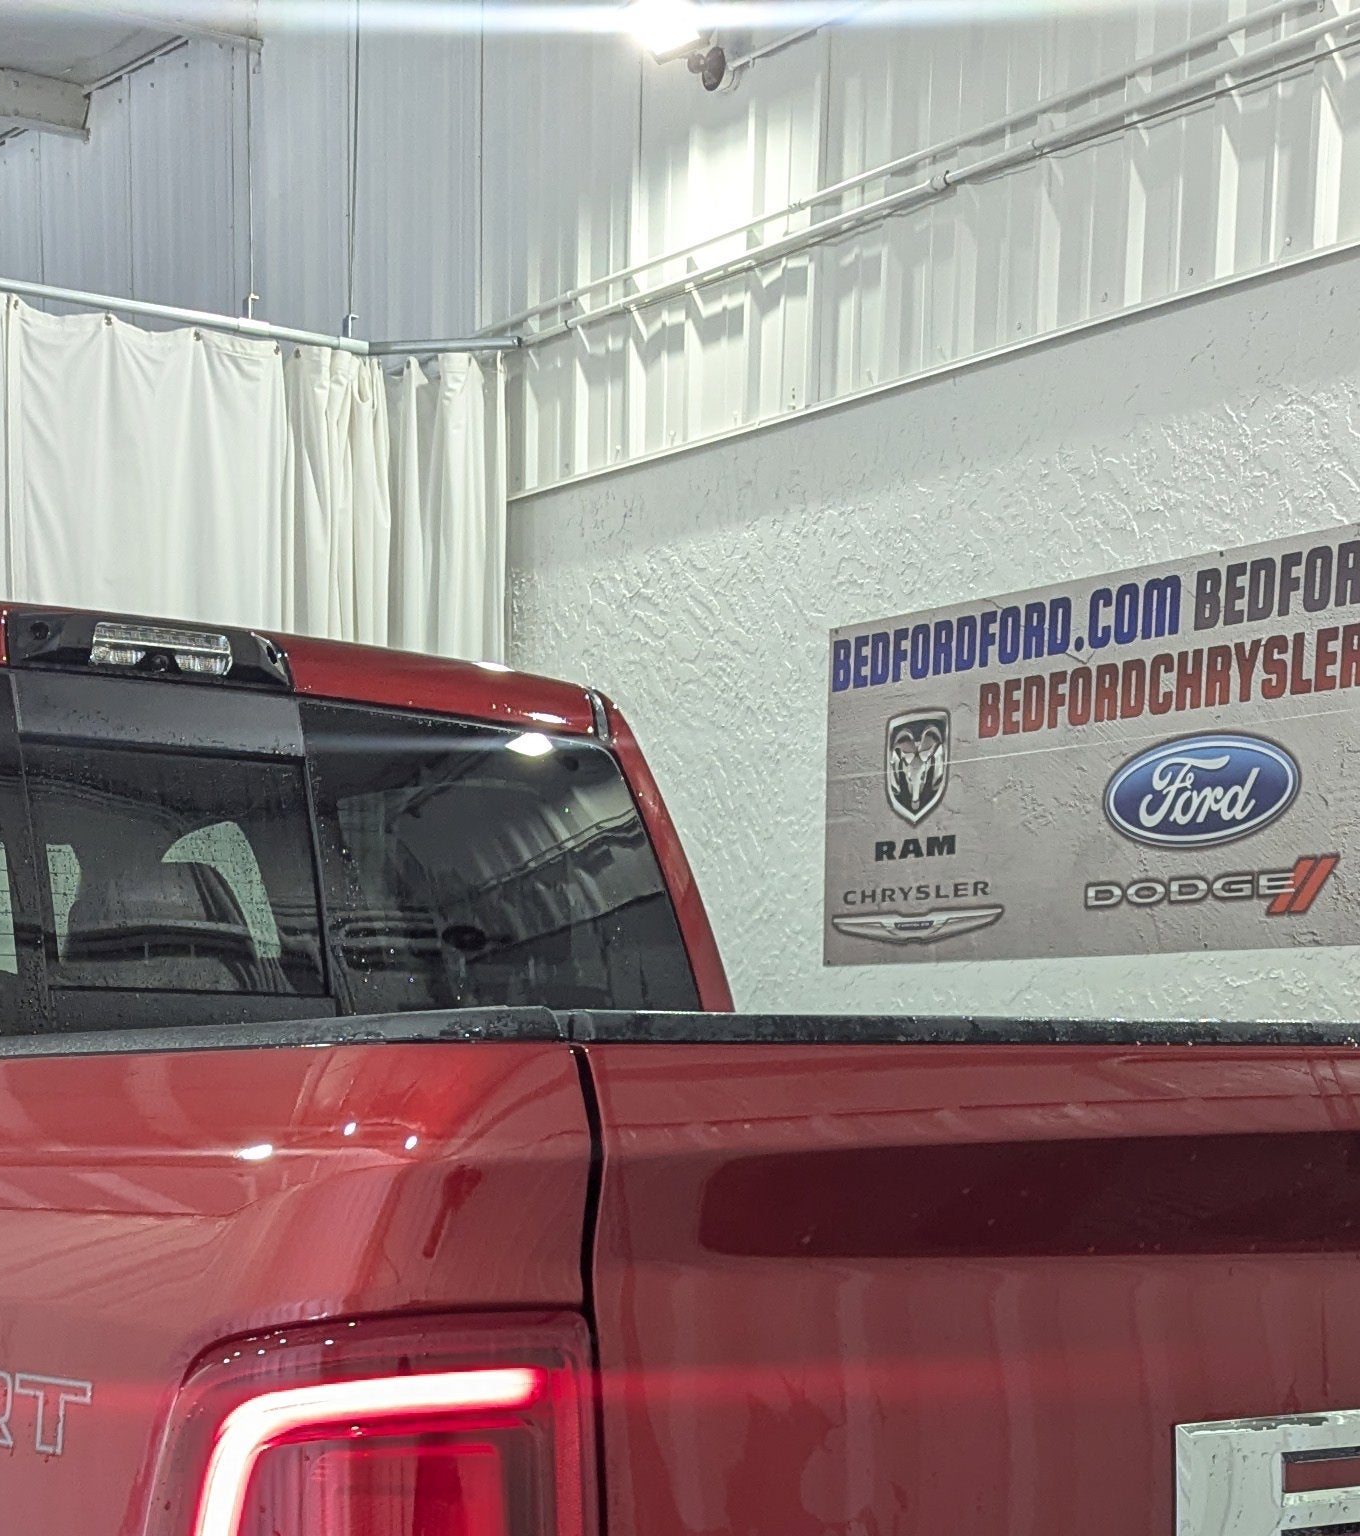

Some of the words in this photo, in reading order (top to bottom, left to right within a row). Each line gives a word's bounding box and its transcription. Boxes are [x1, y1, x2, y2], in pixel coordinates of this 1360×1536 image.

[832, 574, 1180, 692] BEDFORDFORD.COM
[1137, 752, 1257, 825] Ford
[874, 834, 956, 862] RAM
[843, 880, 990, 905] CHRYSLER
[1084, 869, 1296, 910] DODGE
